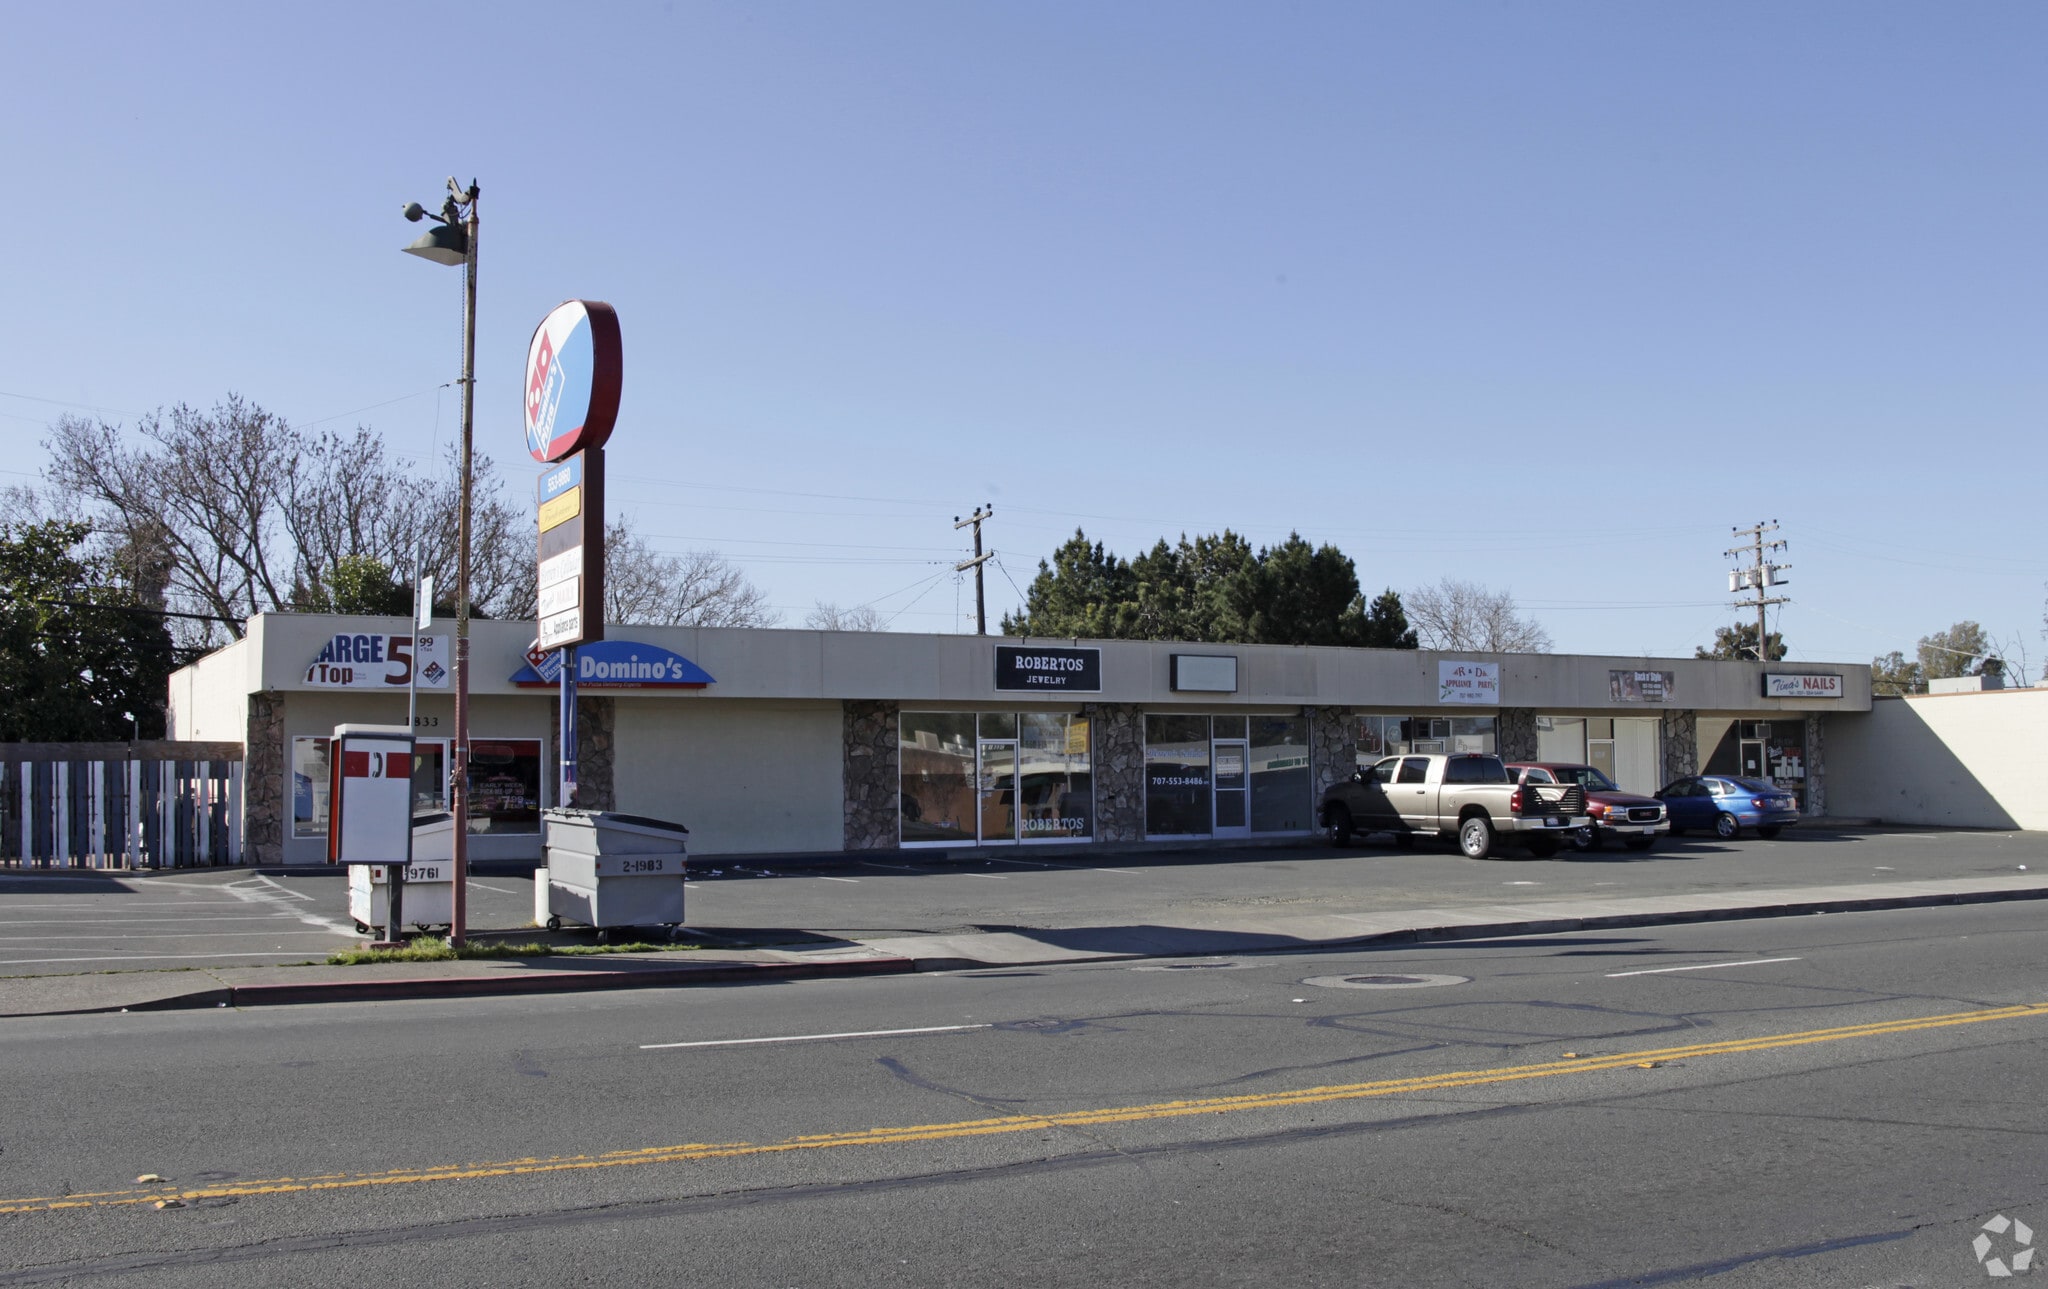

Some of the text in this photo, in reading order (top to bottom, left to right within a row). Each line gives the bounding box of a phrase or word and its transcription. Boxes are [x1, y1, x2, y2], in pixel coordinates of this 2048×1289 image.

[536, 362, 557, 436] Domino's
[540, 404, 555, 449] Pizza
[313, 635, 383, 663] ARGE
[385, 636, 418, 685] 5
[419, 637, 433, 647] 99
[539, 653, 560, 673] Domino
[580, 654, 683, 680] Domino's
[1015, 655, 1084, 671] ROBERTOS
[318, 664, 353, 685] Top
[1458, 666, 1466, 677] R
[1475, 667, 1483, 677] D
[1026, 675, 1066, 685] JEWELRY
[1445, 679, 1472, 688] APPLIANCE
[1772, 677, 1836, 692] Tina's NAILS
[406, 716, 438, 727] 1833
[1152, 777, 1203, 785] 707-553-8486
[1020, 817, 1084, 831] ROBERTOS
[623, 859, 663, 872] 2-1983
